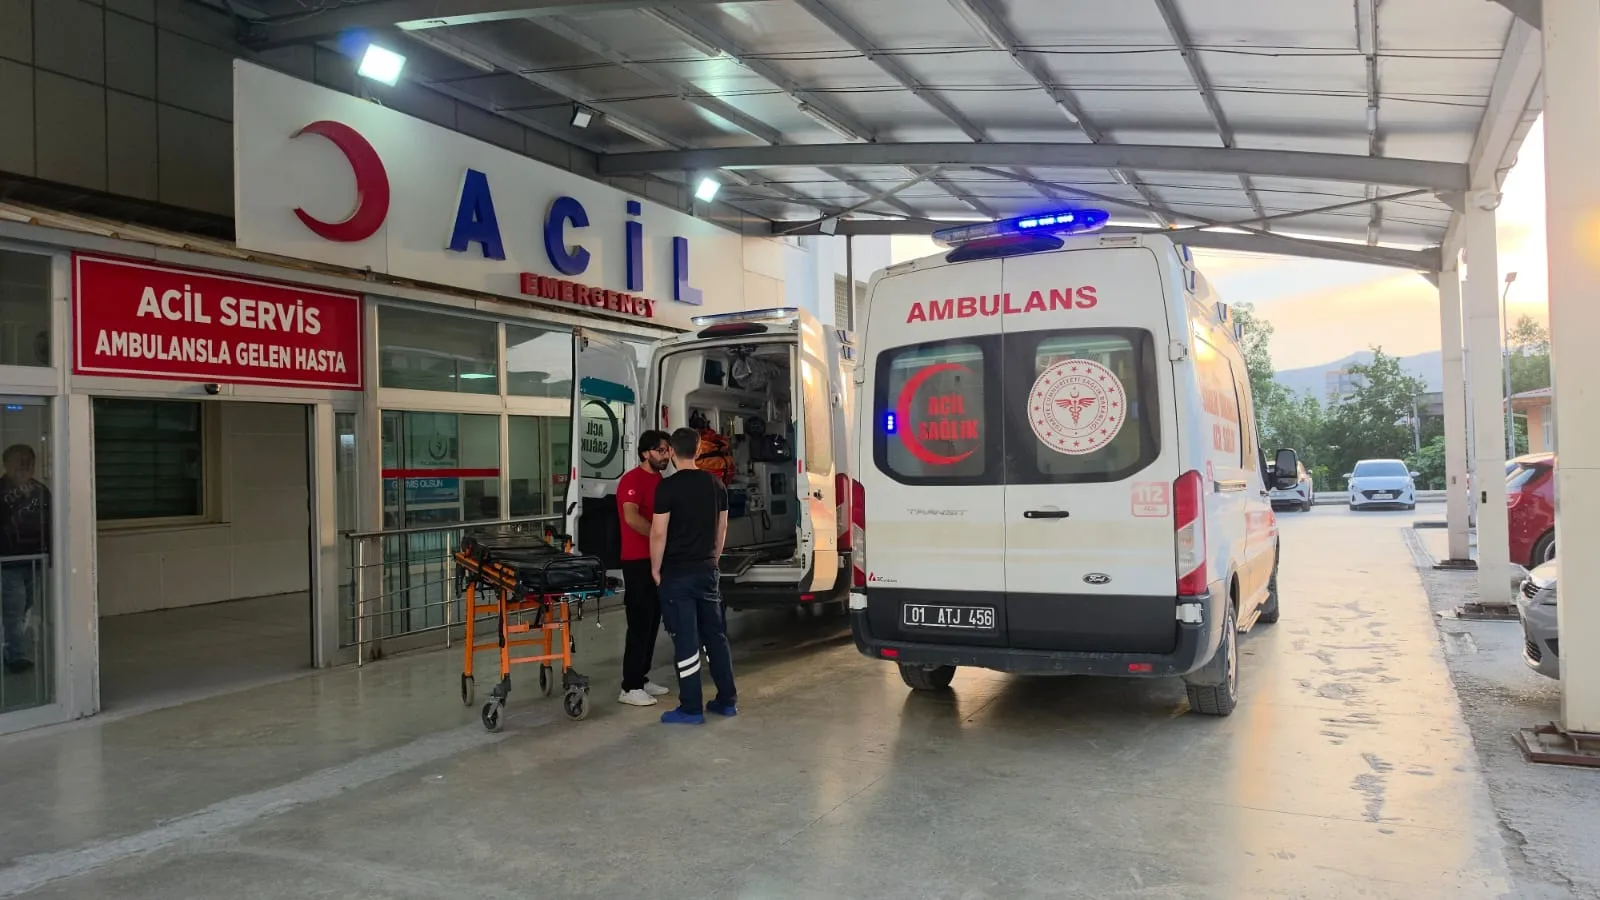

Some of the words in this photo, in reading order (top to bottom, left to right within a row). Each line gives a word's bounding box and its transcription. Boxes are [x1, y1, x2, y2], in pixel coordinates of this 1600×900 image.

[446, 168, 703, 305] ACİL
[137, 284, 211, 324] ACİL
[219, 296, 321, 335] SERVİS
[520, 272, 655, 318] EMERGENCY
[906, 285, 1098, 324] AMBULANS
[95, 329, 232, 366] AMBULANSLA
[236, 342, 292, 370] GELEN
[295, 348, 347, 374] HASTA
[928, 392, 966, 416] ACİL
[918, 418, 979, 440] SAĞLIK
[1138, 485, 1164, 503] 112
[911, 607, 925, 623] 01
[938, 608, 960, 624] ATJ
[968, 609, 992, 626] 456
